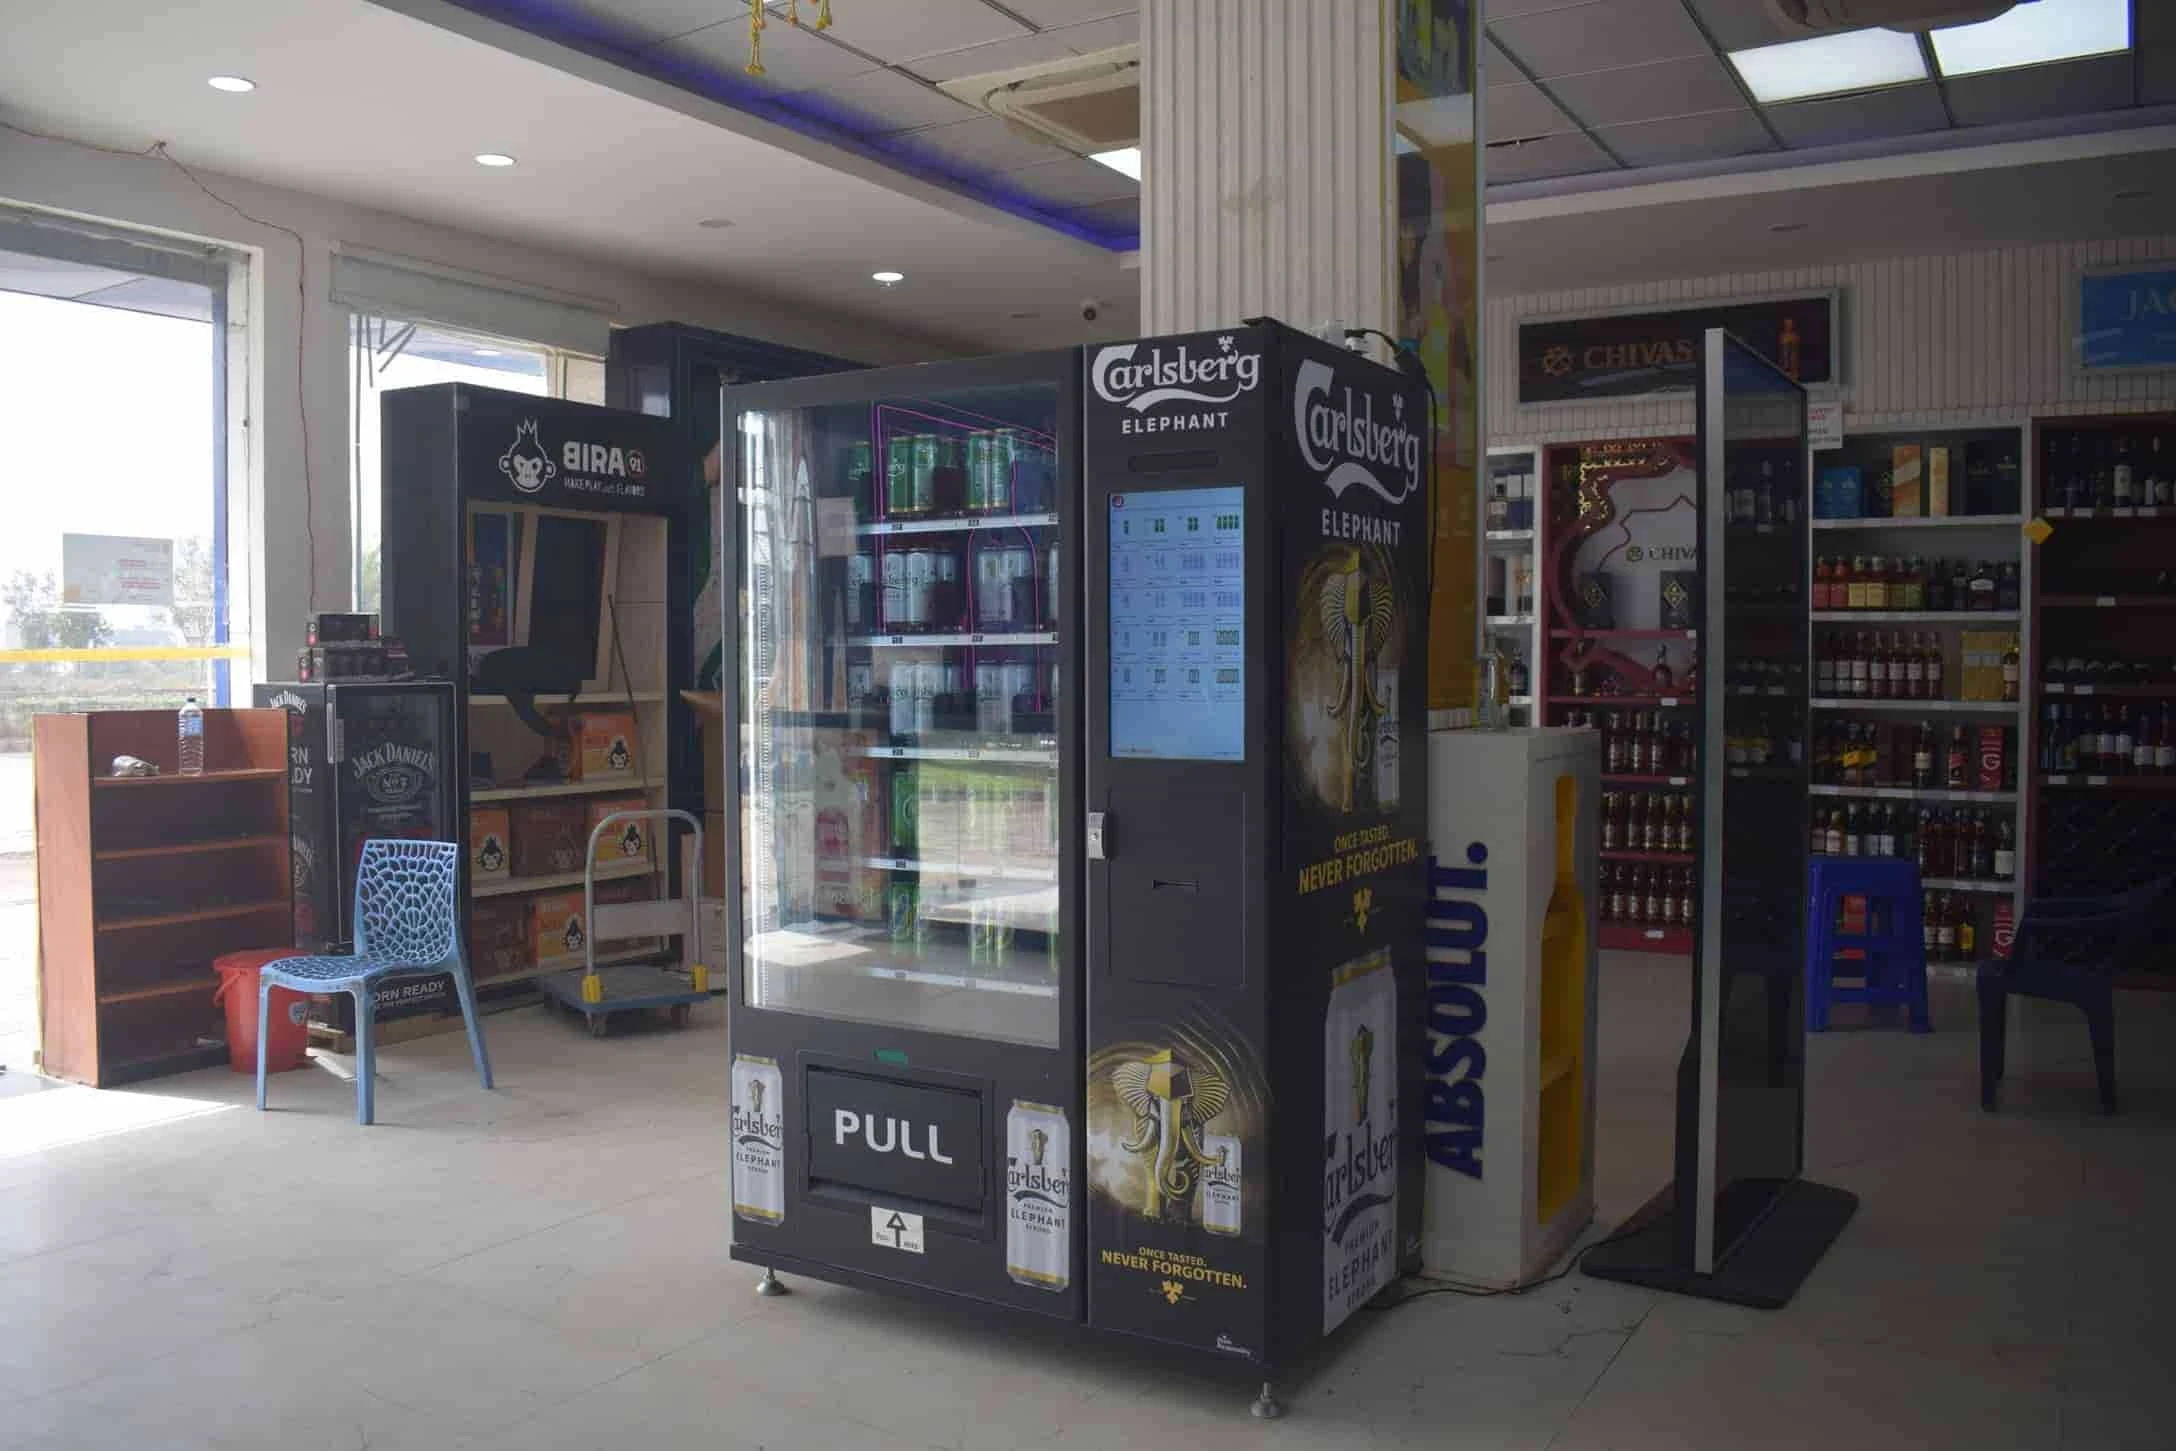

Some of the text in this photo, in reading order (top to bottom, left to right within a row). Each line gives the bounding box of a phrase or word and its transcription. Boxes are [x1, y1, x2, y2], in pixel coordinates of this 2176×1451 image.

[1583, 337, 1695, 370] CHIVAS
[1091, 336, 1262, 408] Carlsberg
[1120, 411, 1230, 435] ELEPHANT
[1294, 358, 1421, 500] Carlsberg
[562, 440, 626, 477] BIRA
[1320, 508, 1402, 547] ELEPHANT
[351, 745, 385, 778] JACK
[1334, 831, 1357, 852] ONCE
[1298, 839, 1418, 896] NEVER FORGOTTEN.
[374, 987, 401, 1003] ORN
[403, 980, 446, 998] READY
[834, 1107, 953, 1165] PULL
[735, 1151, 781, 1169] ELEPHANT
[1010, 1207, 1066, 1229] ELEPHANT
[1100, 1248, 1248, 1290] NEVER FORGOTTEN.
[1138, 1246, 1168, 1260] ONCE
[1328, 1228, 1394, 1302] ELEPHANT
